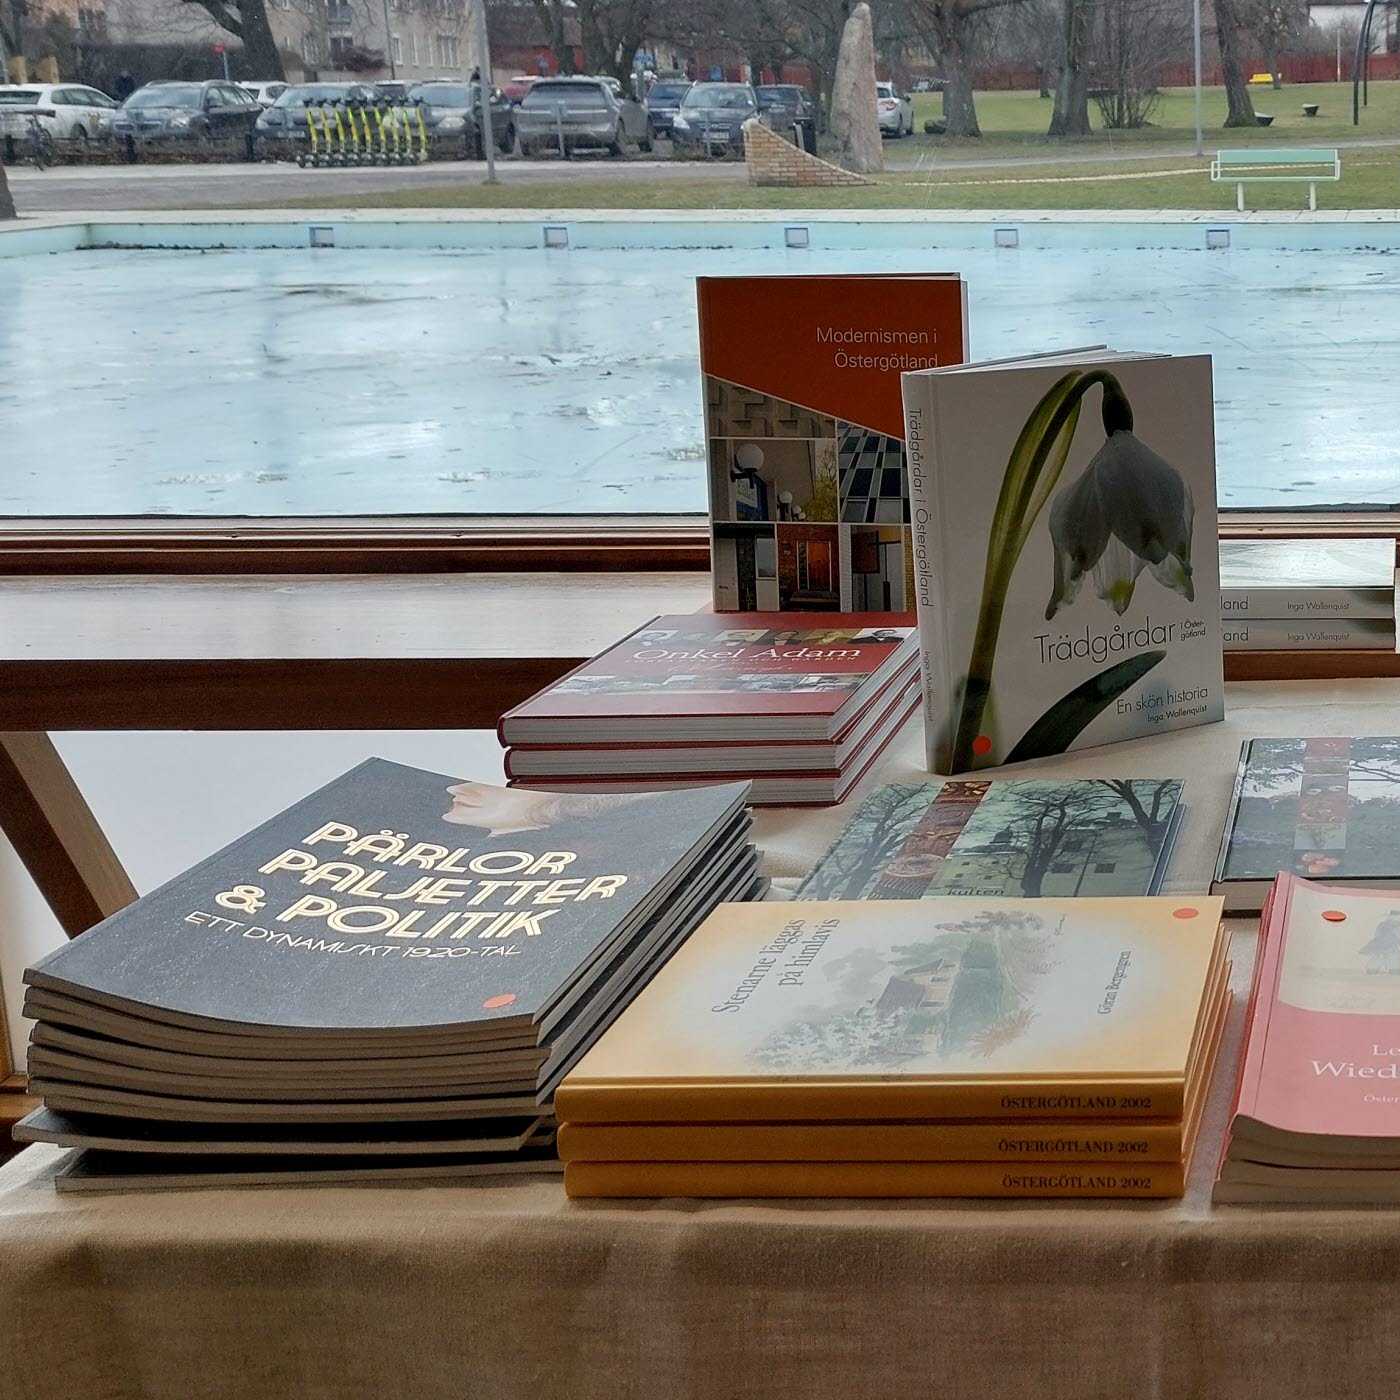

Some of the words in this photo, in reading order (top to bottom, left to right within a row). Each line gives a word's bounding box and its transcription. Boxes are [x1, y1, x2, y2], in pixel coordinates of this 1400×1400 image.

[816, 327, 929, 344] Modernismen
[933, 328, 938, 344] i
[834, 348, 938, 372] Östergötland
[909, 408, 924, 495] Trädgårdar
[915, 508, 935, 607] Östergötland
[1287, 602, 1304, 612] Inga
[1305, 602, 1350, 612] Wallenquist
[1034, 616, 1176, 664] Trädgårdar
[1287, 633, 1304, 642] Inga
[1306, 632, 1350, 642] Wallenquist
[632, 647, 746, 660] Onkel
[749, 647, 861, 659] Adam
[1116, 699, 1132, 715] En
[1136, 694, 1164, 711] skön
[1167, 687, 1208, 705] historia
[1148, 714, 1164, 724] Inga
[1166, 705, 1208, 719] Wallenquist
[301, 820, 578, 876] PÄRLOR
[257, 849, 629, 906] PALJETTER
[214, 884, 267, 915] &
[276, 894, 562, 939] POLITIK
[184, 911, 246, 933] ETT
[243, 925, 402, 958] DYNAMISKT
[401, 945, 523, 960] 1920-TAL
[784, 918, 841, 967] himlavis
[711, 957, 777, 1013] Stenarne
[759, 919, 807, 954] läggas
[777, 970, 805, 986] på
[1097, 991, 1118, 1015] Göran
[1001, 1096, 1116, 1109] ÖSTERGÖTLAND
[1120, 1097, 1151, 1109] 2002
[998, 1139, 1114, 1153] ÖSTERGÖTLAND
[1117, 1141, 1149, 1153] 2002
[1002, 1175, 1117, 1189] ÖSTERGÖTLAND
[1120, 1177, 1151, 1189] 2002
